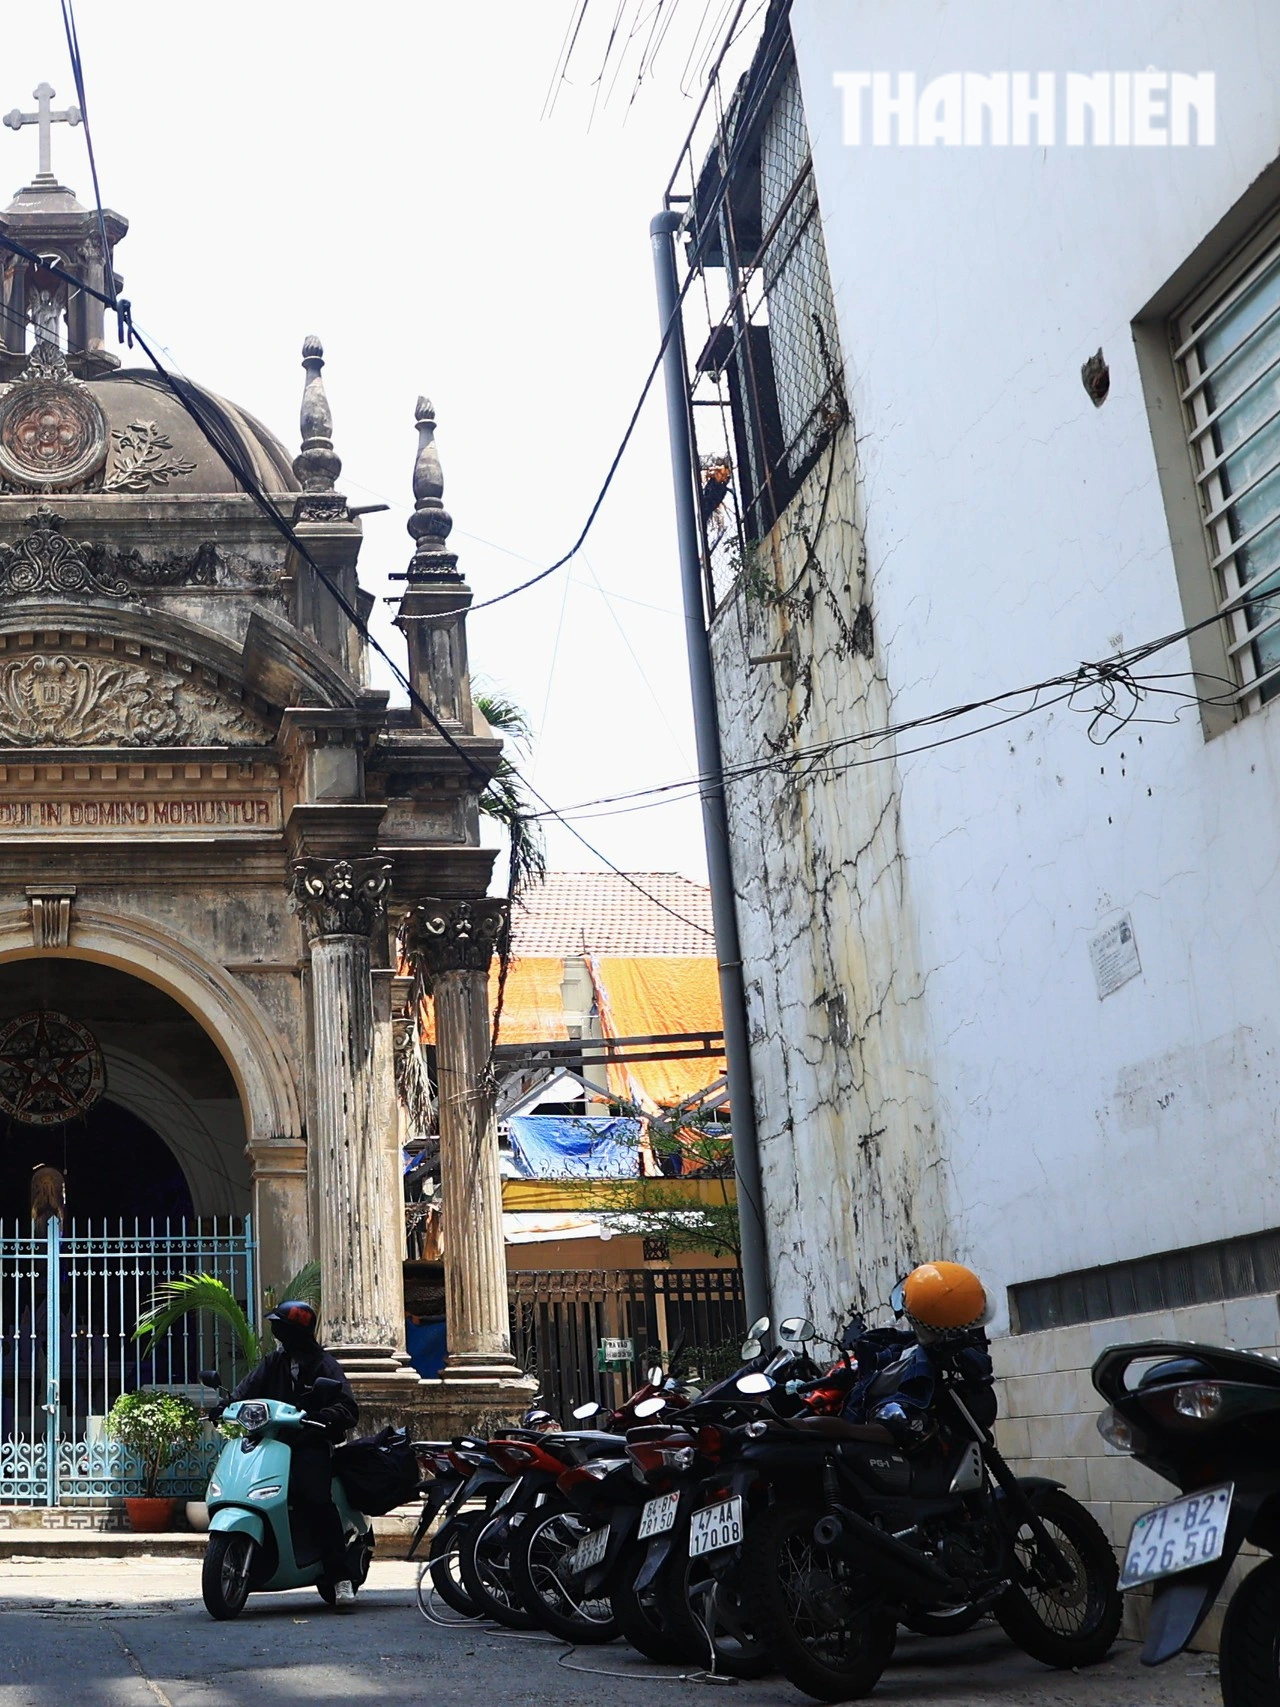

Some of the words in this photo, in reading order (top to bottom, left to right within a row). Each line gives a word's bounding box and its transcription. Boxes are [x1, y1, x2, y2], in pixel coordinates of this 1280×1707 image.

[40, 802, 62, 826] IN
[70, 801, 149, 826] DOMINO
[153, 800, 270, 825] MORIUNTUR
[639, 1511, 673, 1536] 781.50
[699, 1502, 733, 1531] 47-AA
[1142, 1494, 1216, 1546] 71-B2
[694, 1522, 740, 1553] 170.08
[1123, 1526, 1218, 1582] 626.50
